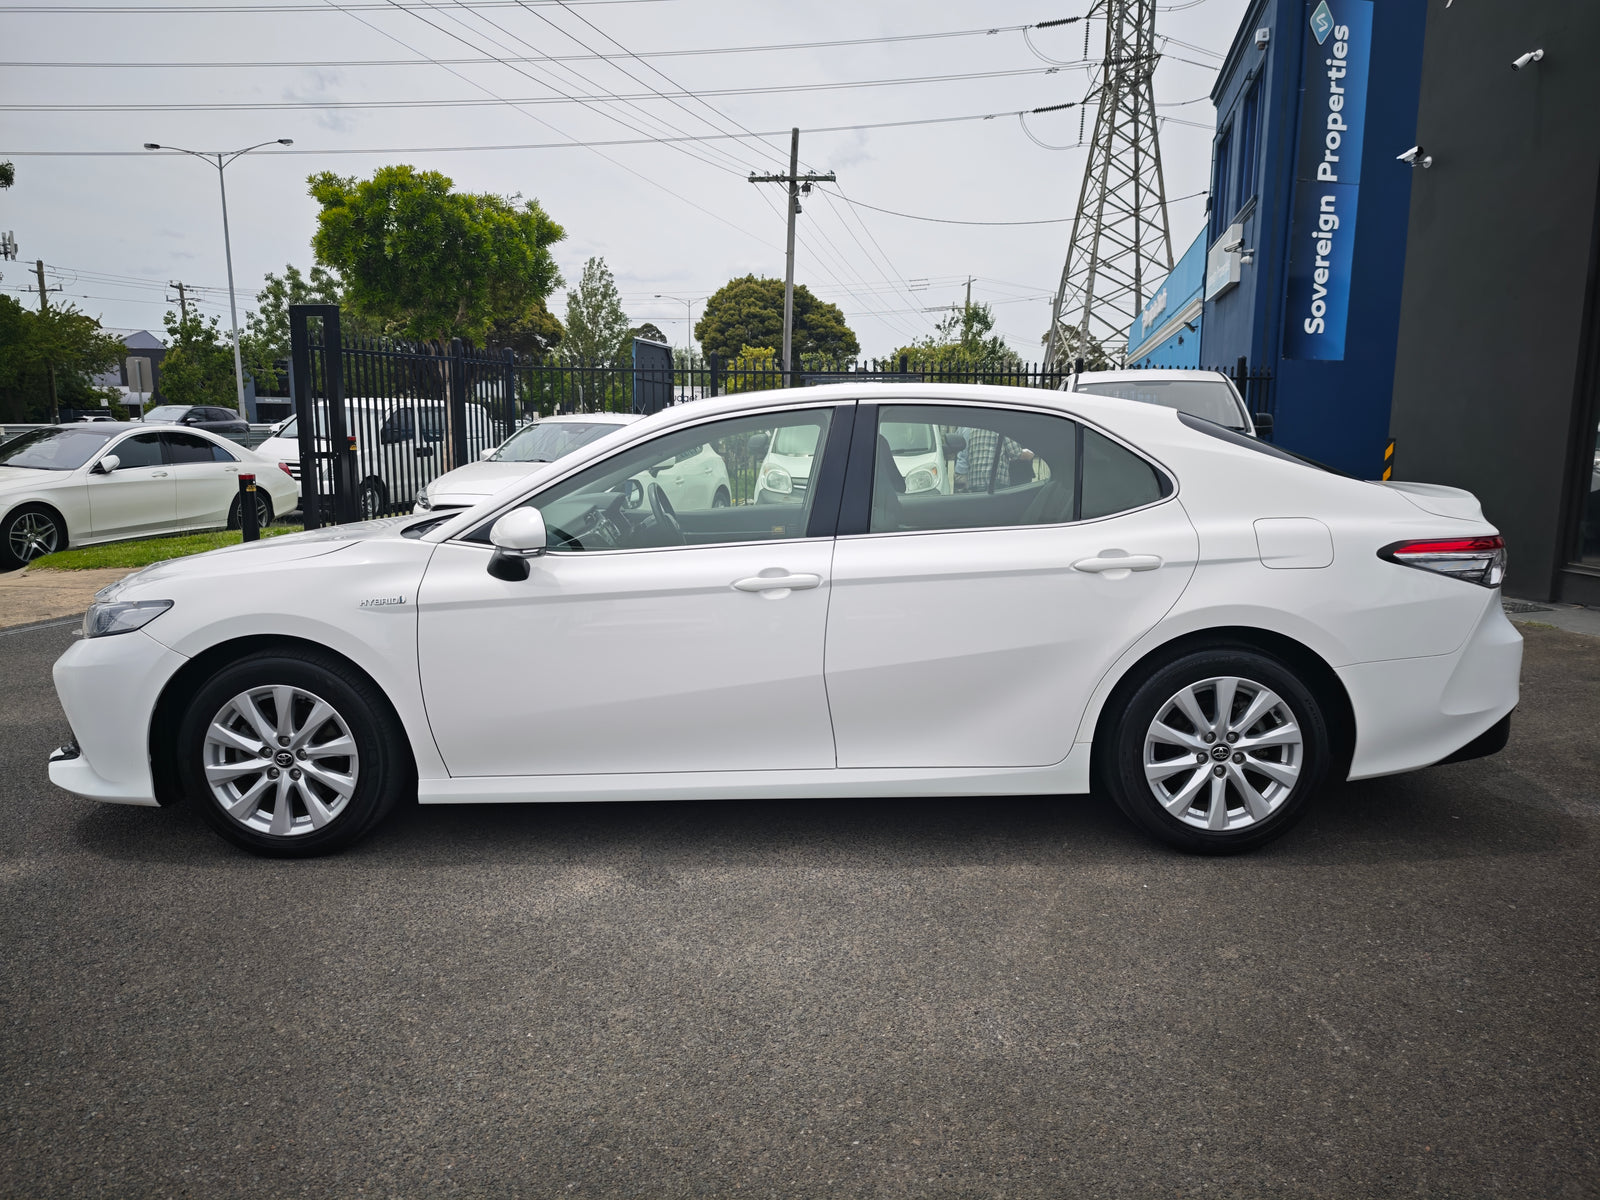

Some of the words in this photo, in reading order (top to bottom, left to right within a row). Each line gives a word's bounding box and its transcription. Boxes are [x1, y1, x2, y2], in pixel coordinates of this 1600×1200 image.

[1317, 25, 1350, 181] Properties
[1304, 195, 1340, 334] Sovereign
[360, 598, 399, 606] HYBRID
